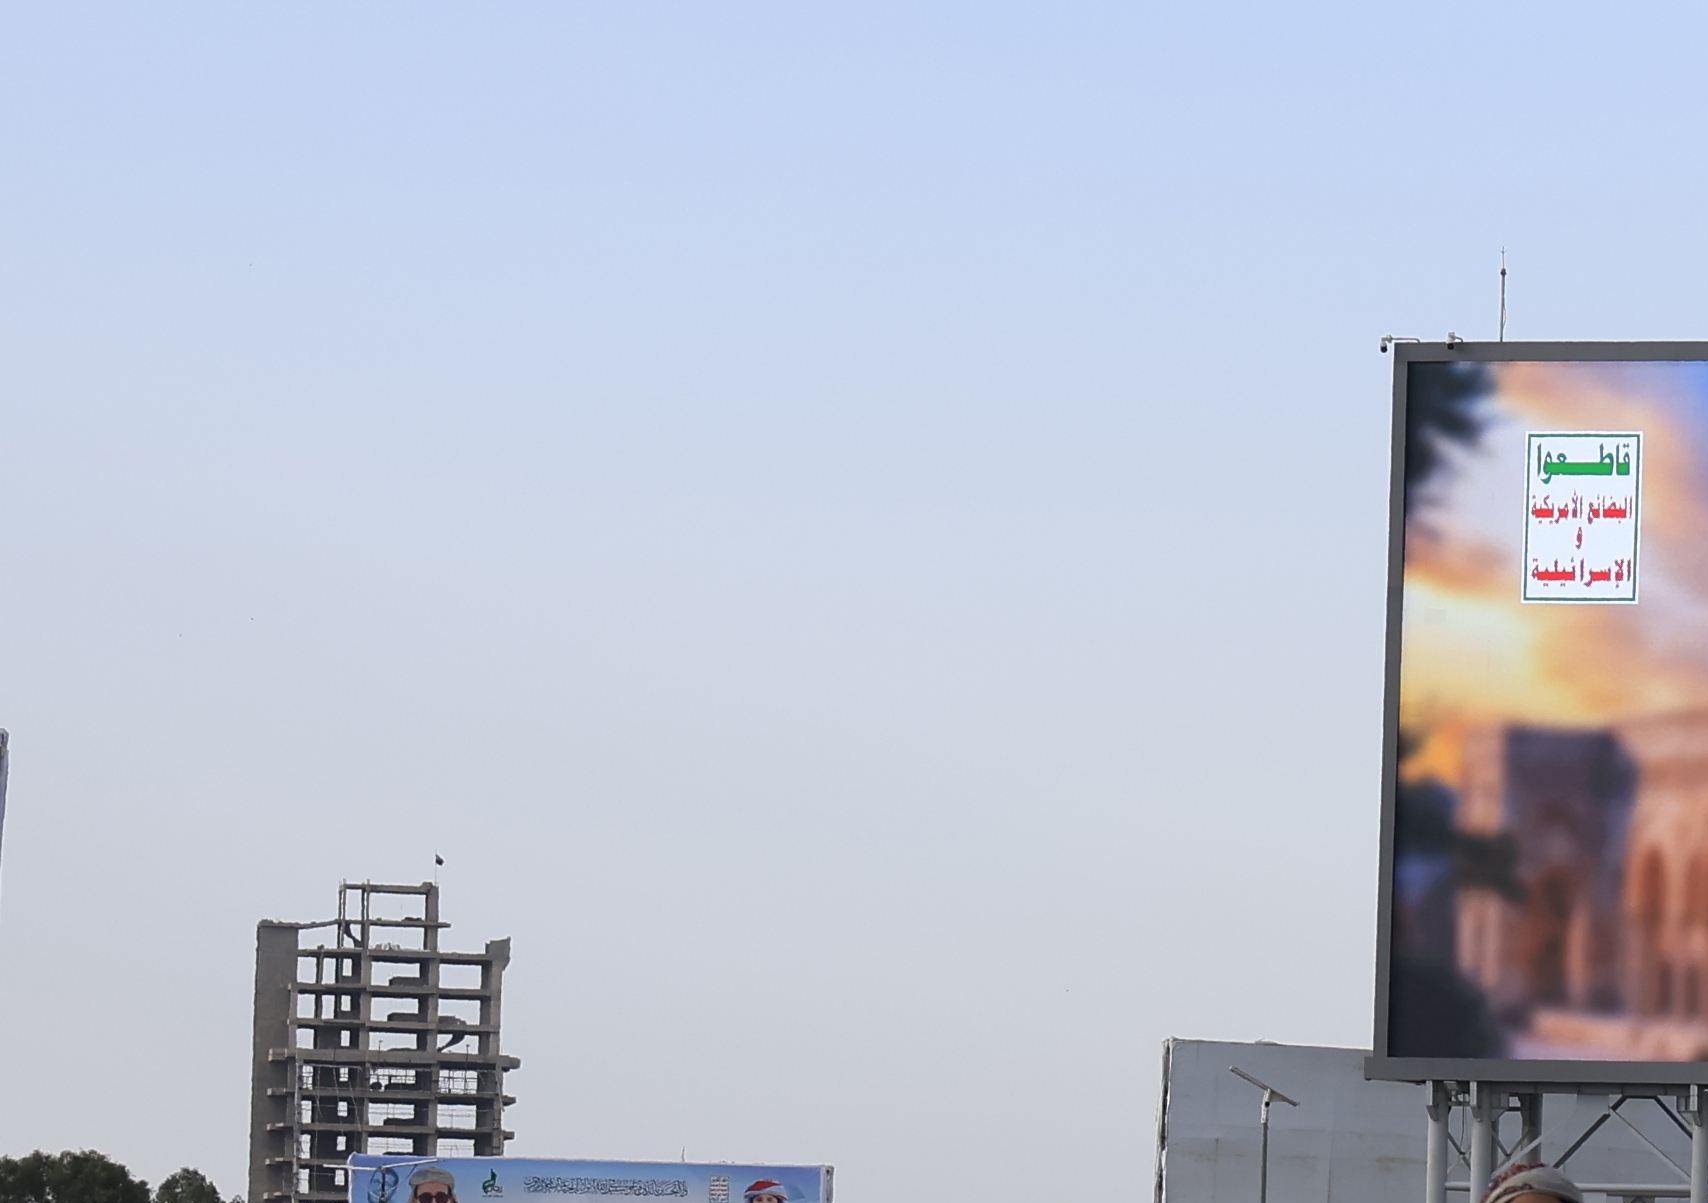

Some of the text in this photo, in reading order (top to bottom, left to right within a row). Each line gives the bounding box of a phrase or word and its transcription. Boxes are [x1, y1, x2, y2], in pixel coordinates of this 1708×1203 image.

[1536, 442, 1631, 485] قاطعوا
[1531, 489, 1633, 525] البضائع الأمريكية
[1574, 526, 1583, 550] و
[1531, 556, 1632, 589] الإسرائيلية
